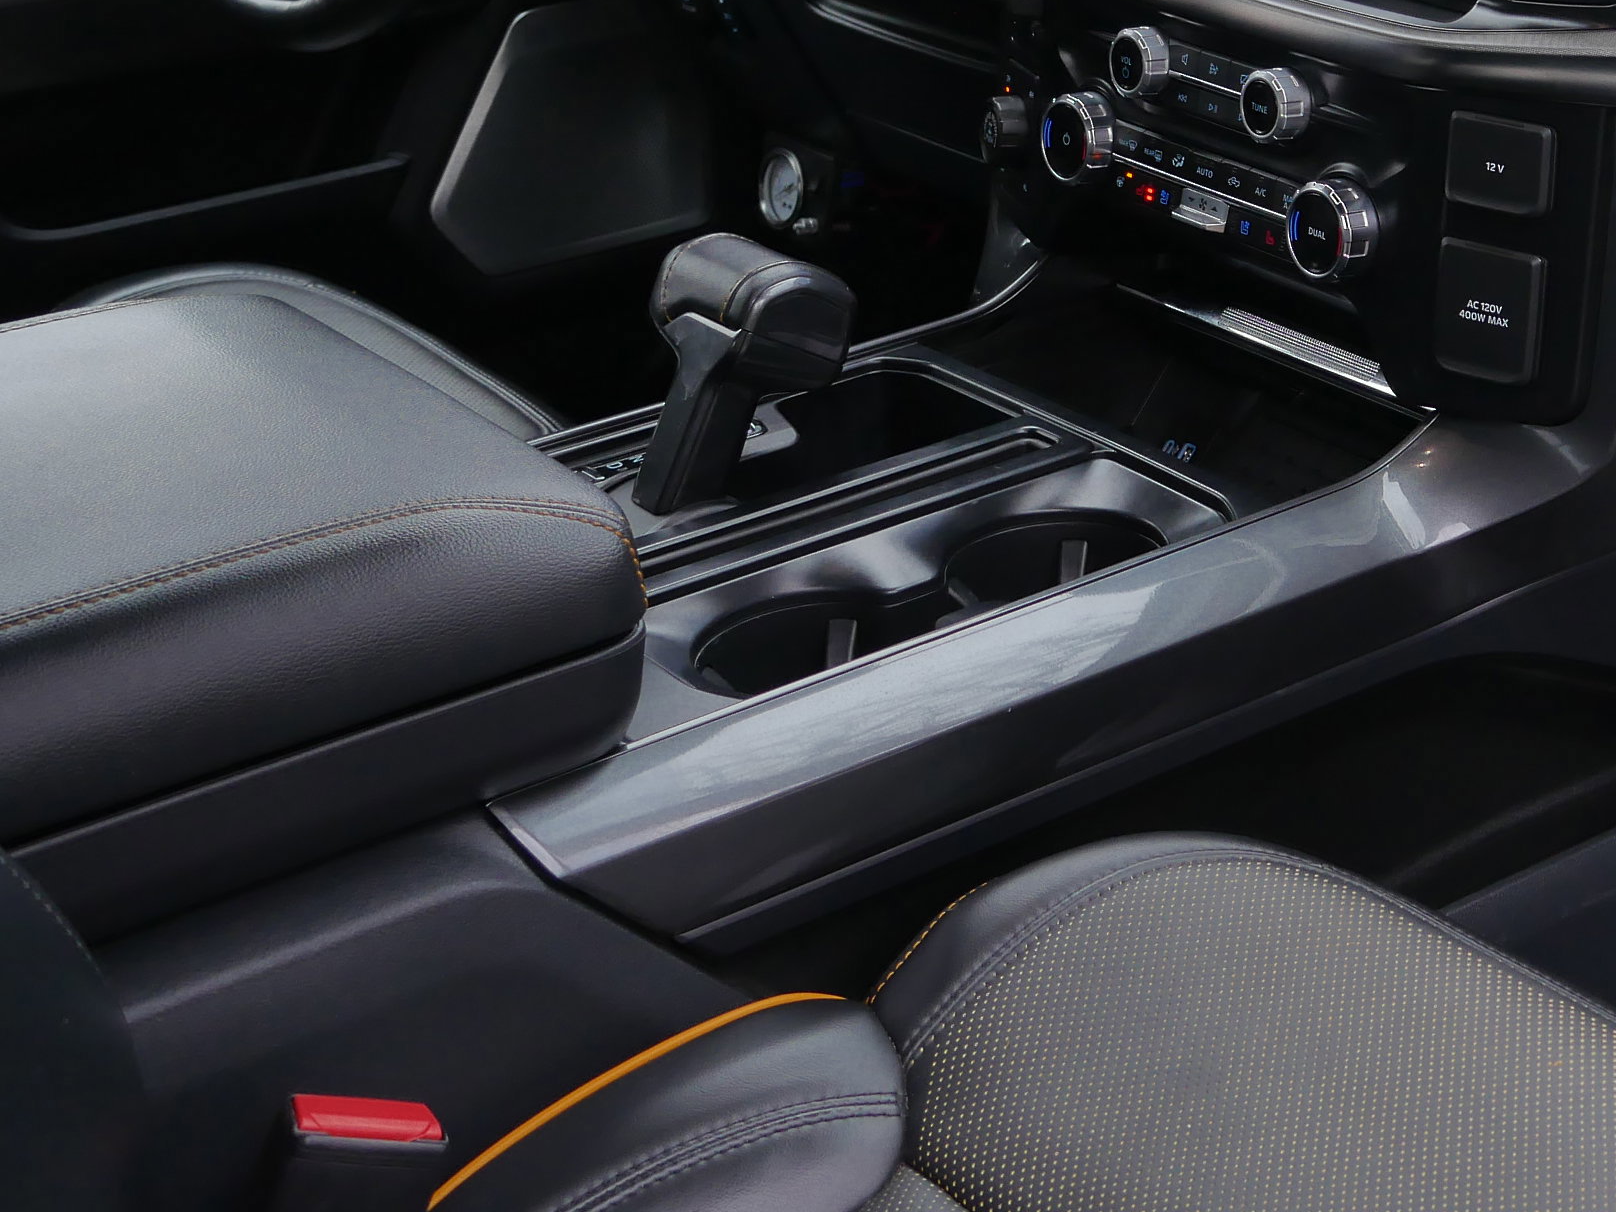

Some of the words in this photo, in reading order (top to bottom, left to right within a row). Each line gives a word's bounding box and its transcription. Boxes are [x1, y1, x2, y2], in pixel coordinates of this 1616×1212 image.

[1121, 55, 1132, 66] VOL
[1252, 102, 1268, 115] TUNE
[1196, 166, 1213, 179] AUTO
[1485, 161, 1497, 173] 12
[1497, 163, 1505, 174] V
[1254, 187, 1267, 198] A/C
[1308, 226, 1326, 240] DUAL
[1466, 299, 1479, 311] AC
[1480, 302, 1503, 315] 120V
[1459, 309, 1486, 324] 400W
[1487, 315, 1509, 328] MAX
